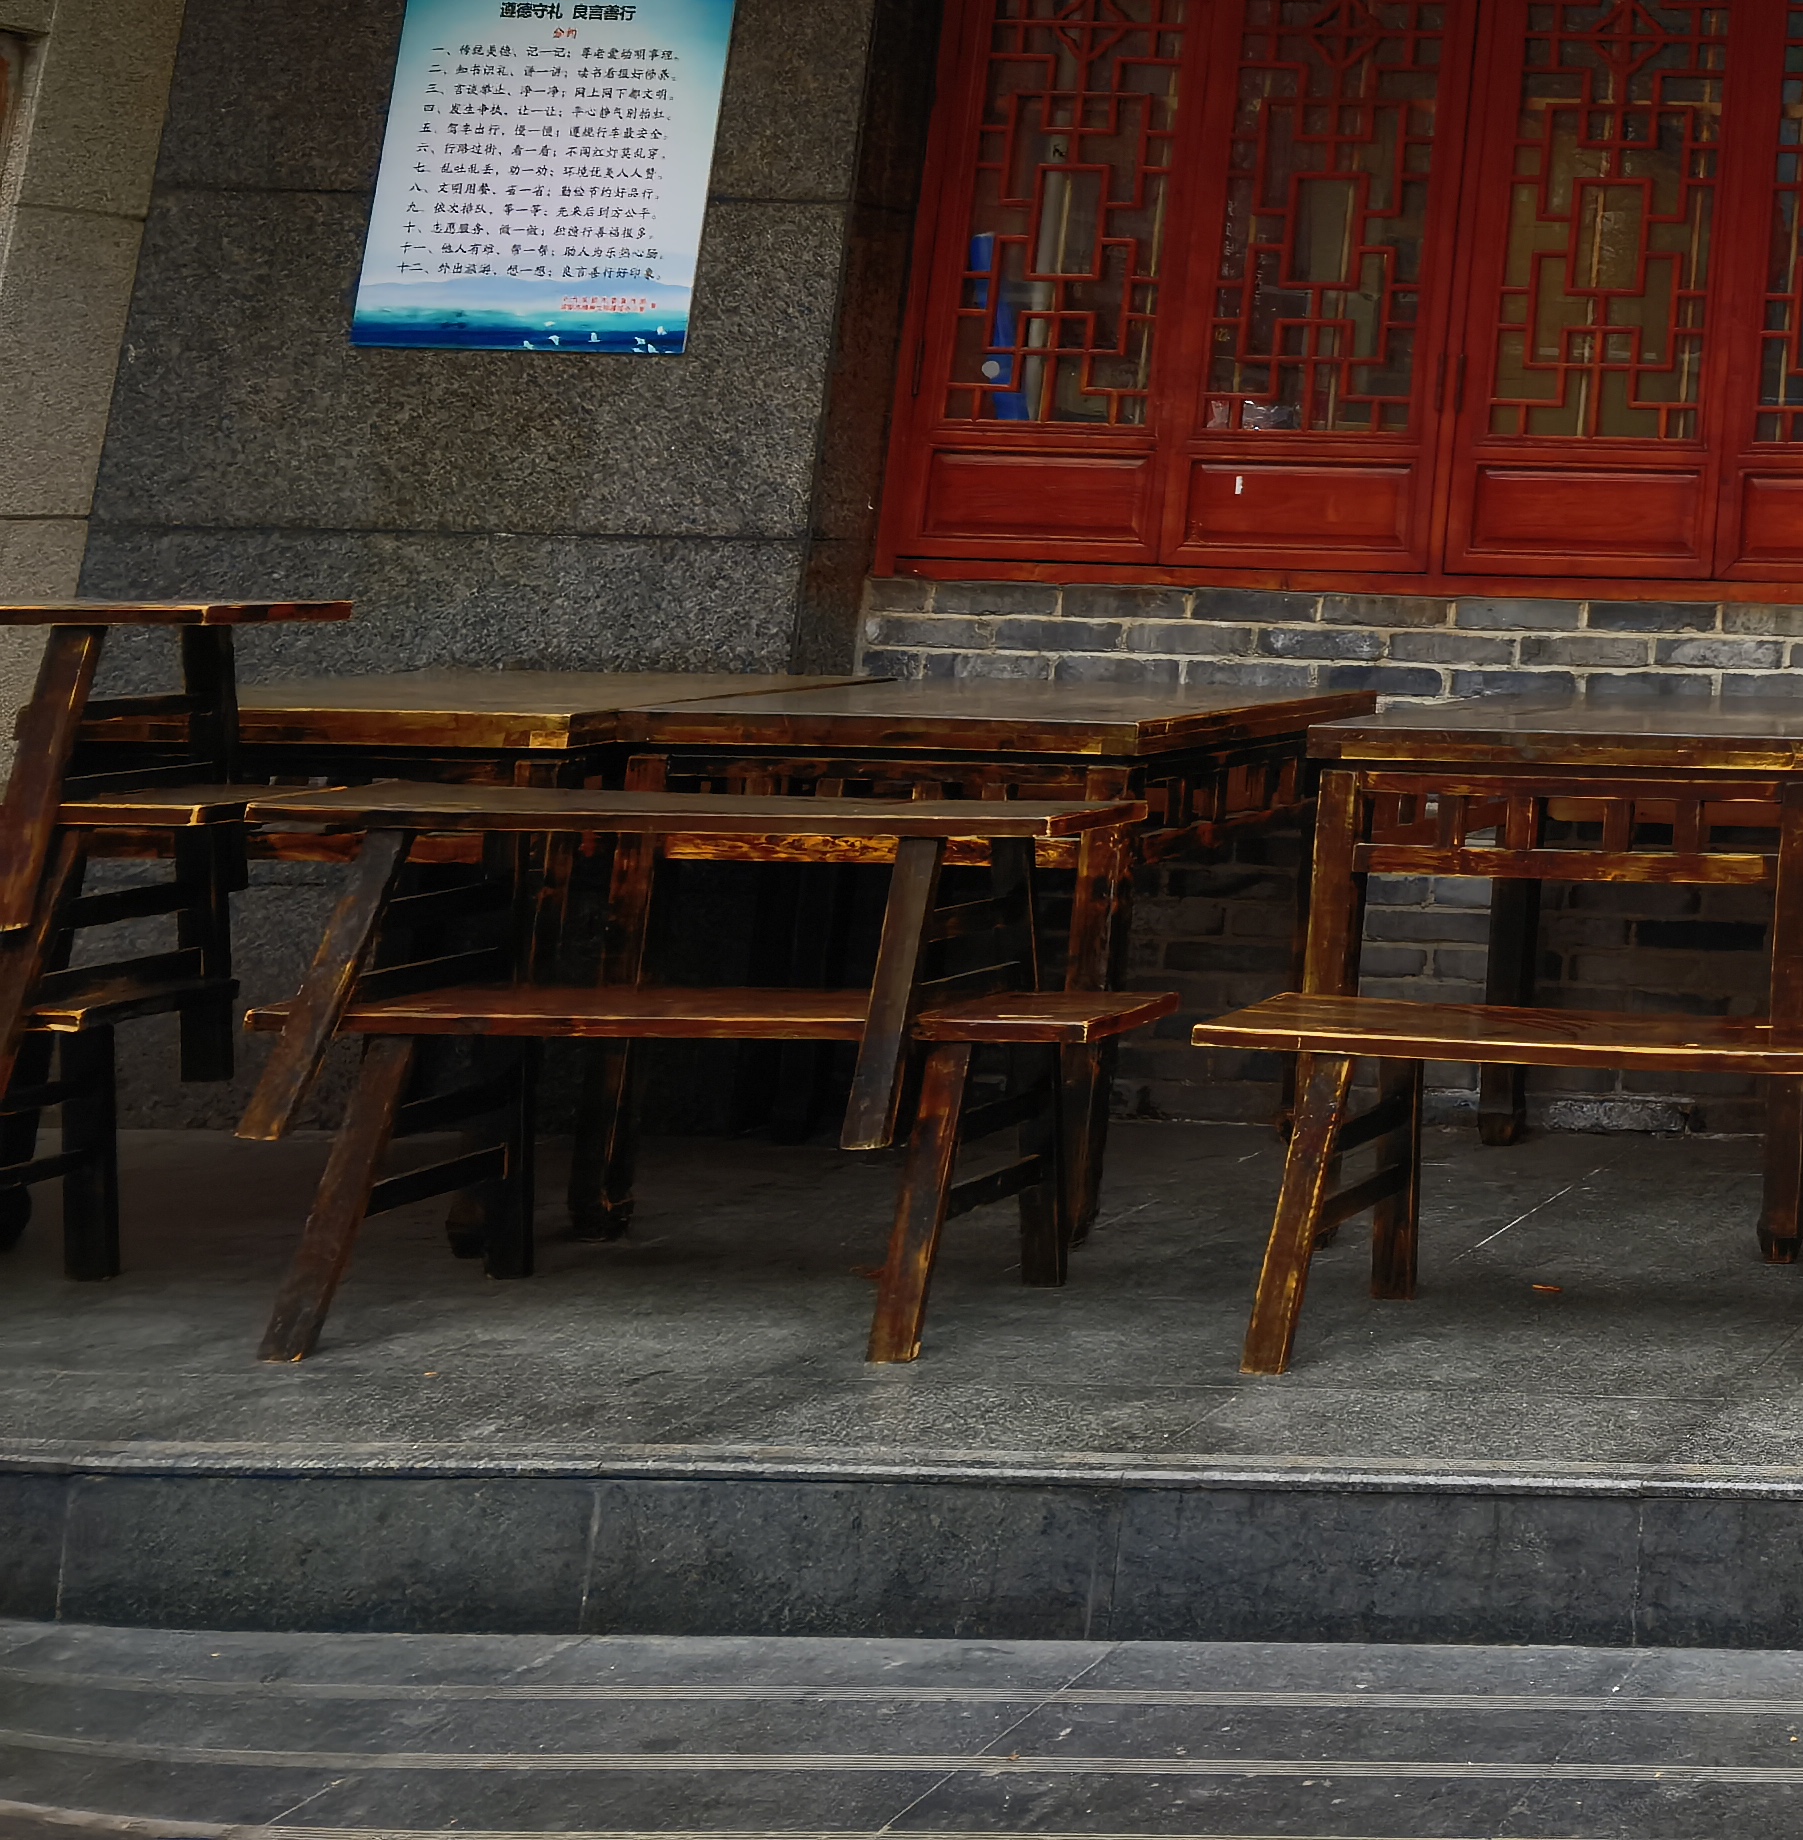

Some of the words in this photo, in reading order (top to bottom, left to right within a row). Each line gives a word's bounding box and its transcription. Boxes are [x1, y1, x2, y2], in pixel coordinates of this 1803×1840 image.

[500, 2, 563, 20] 遵德守礼
[572, 4, 637, 22] 良言善行
